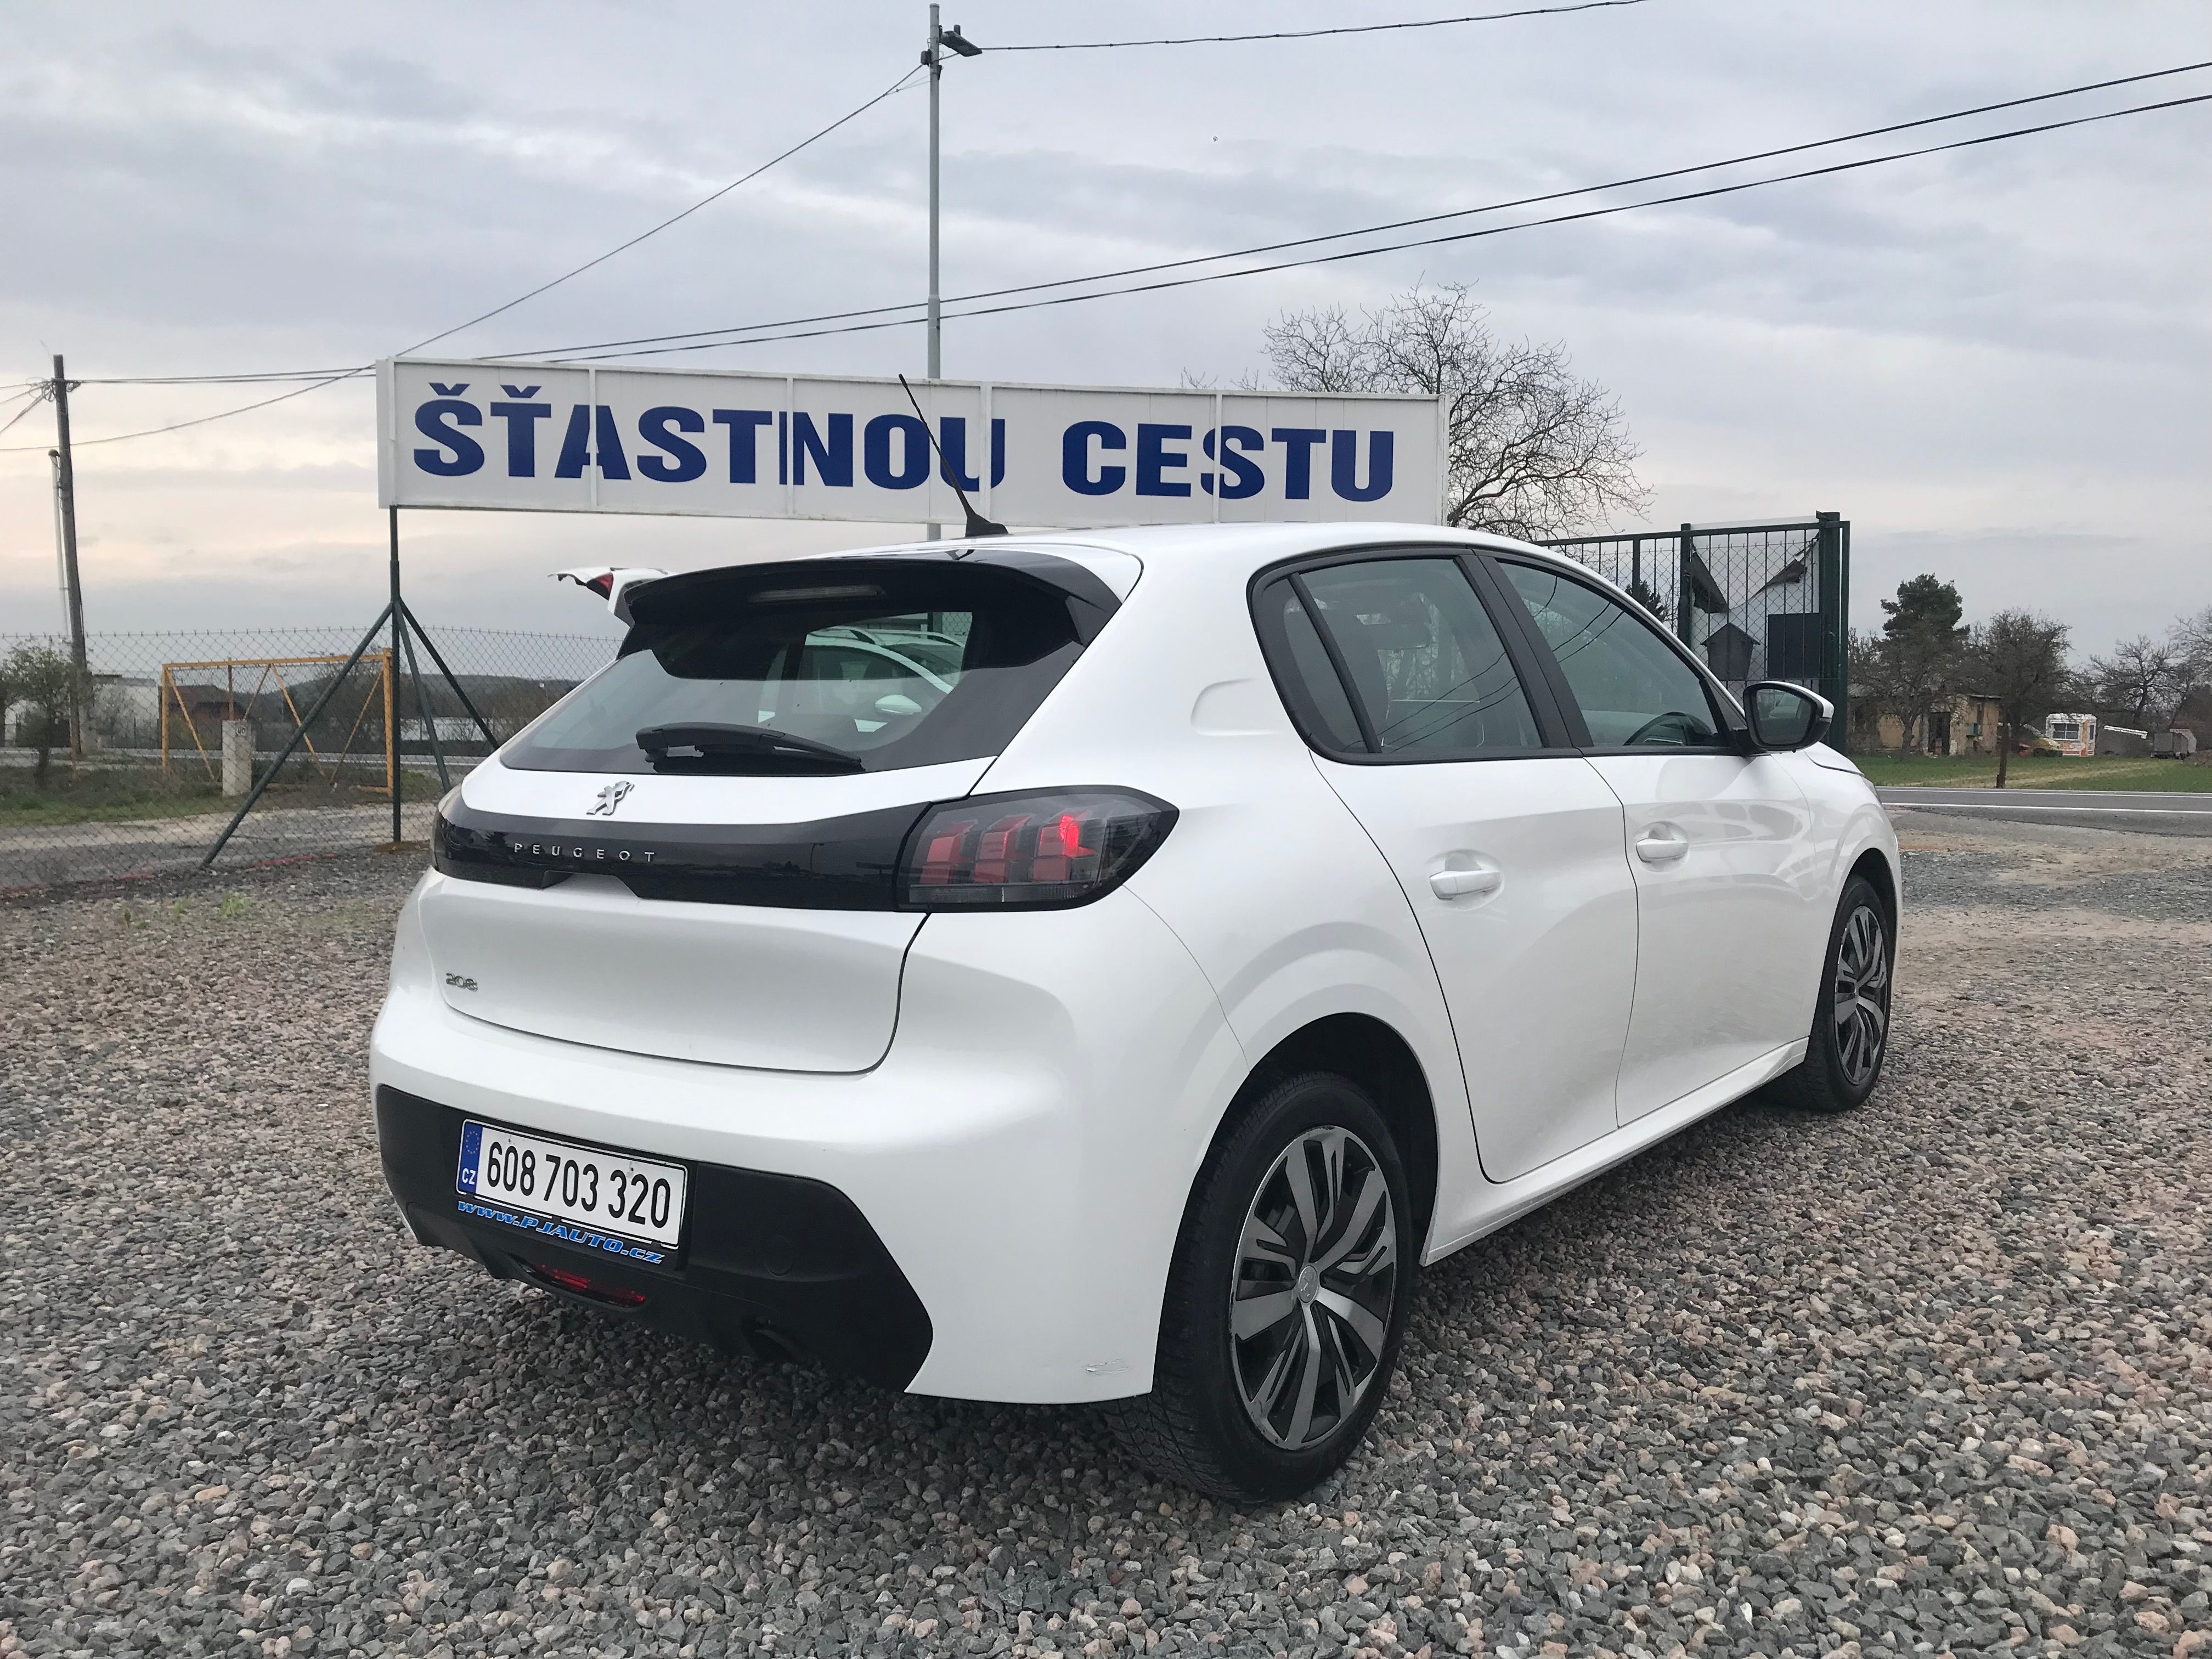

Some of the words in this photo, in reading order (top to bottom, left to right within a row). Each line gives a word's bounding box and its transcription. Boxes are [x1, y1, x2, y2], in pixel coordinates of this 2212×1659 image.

[414, 382, 1005, 492] ŠŤASTNOU
[1062, 420, 1394, 502] CESTU
[514, 843, 655, 862] PEUGEOT
[445, 973, 478, 992] 208
[462, 1167, 476, 1185] CZ
[487, 1141, 536, 1196] 608
[544, 1154, 599, 1211] 703
[608, 1170, 670, 1228] 320
